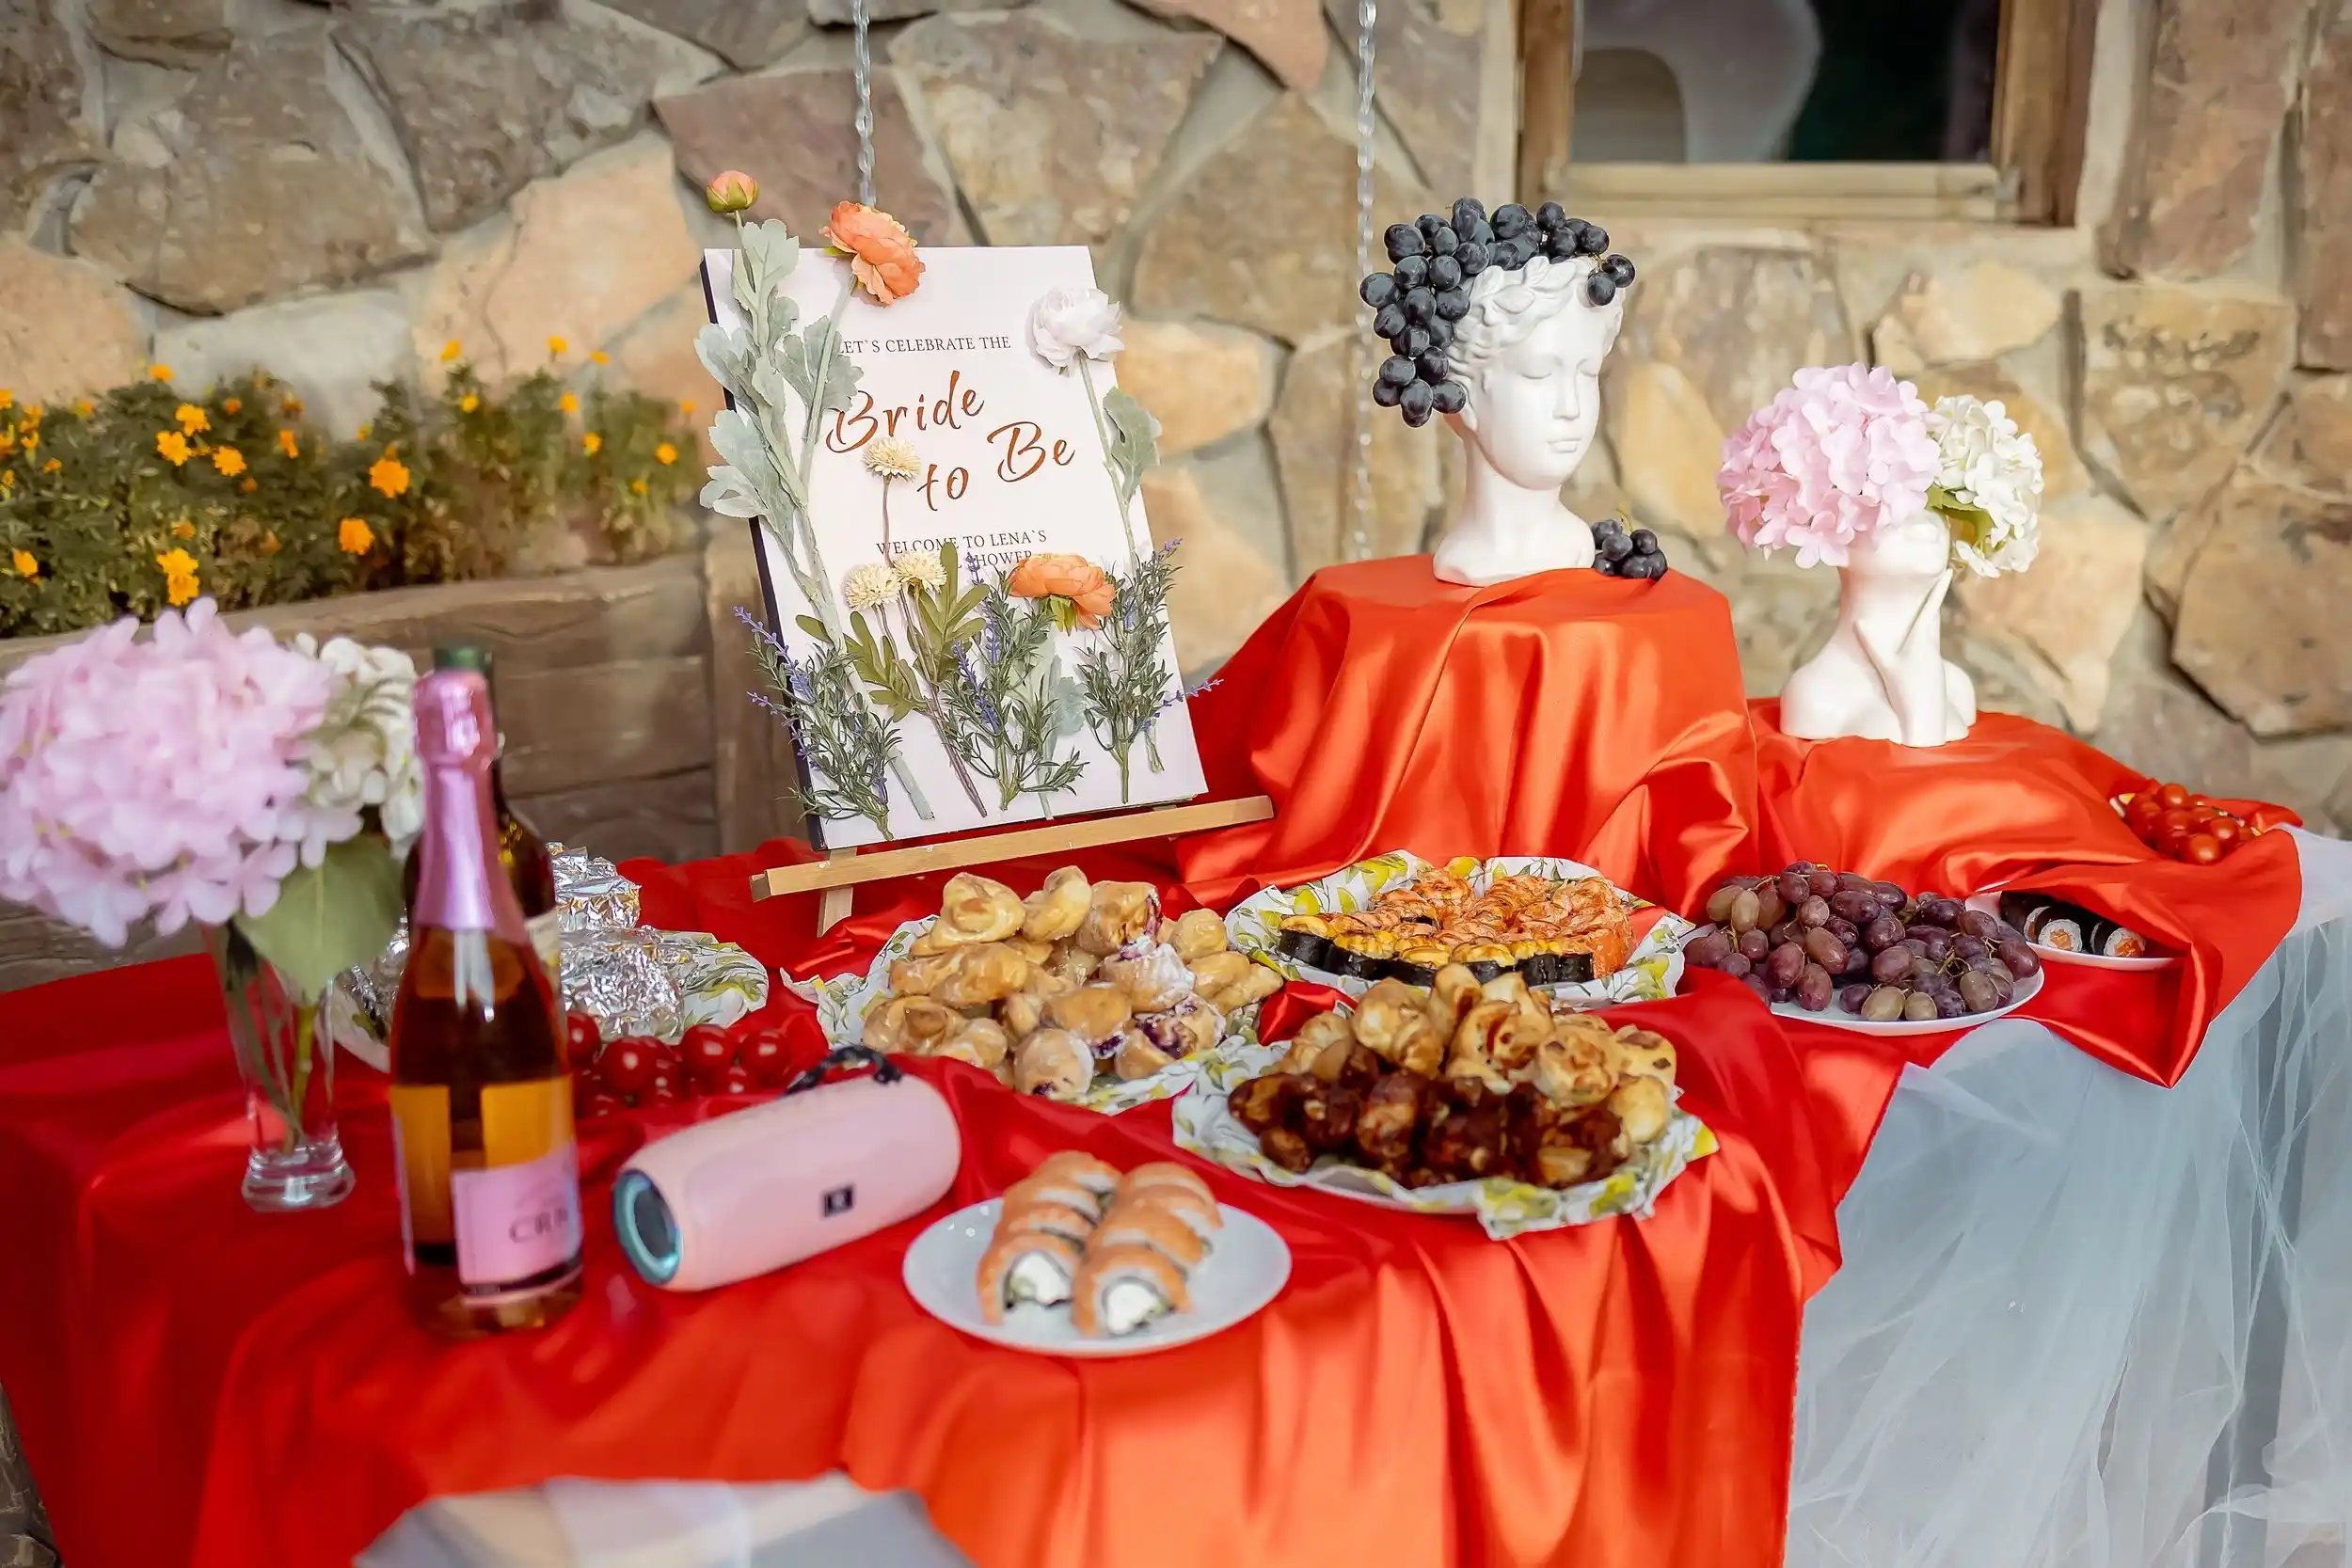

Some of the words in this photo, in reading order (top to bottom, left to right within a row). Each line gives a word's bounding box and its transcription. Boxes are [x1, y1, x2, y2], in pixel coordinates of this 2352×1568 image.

[885, 337, 976, 353] CELEBRATE
[979, 336, 1011, 349] THE
[826, 370, 985, 453] Bride
[917, 464, 969, 512] to
[987, 421, 1075, 483] Be
[962, 535, 985, 548] TO
